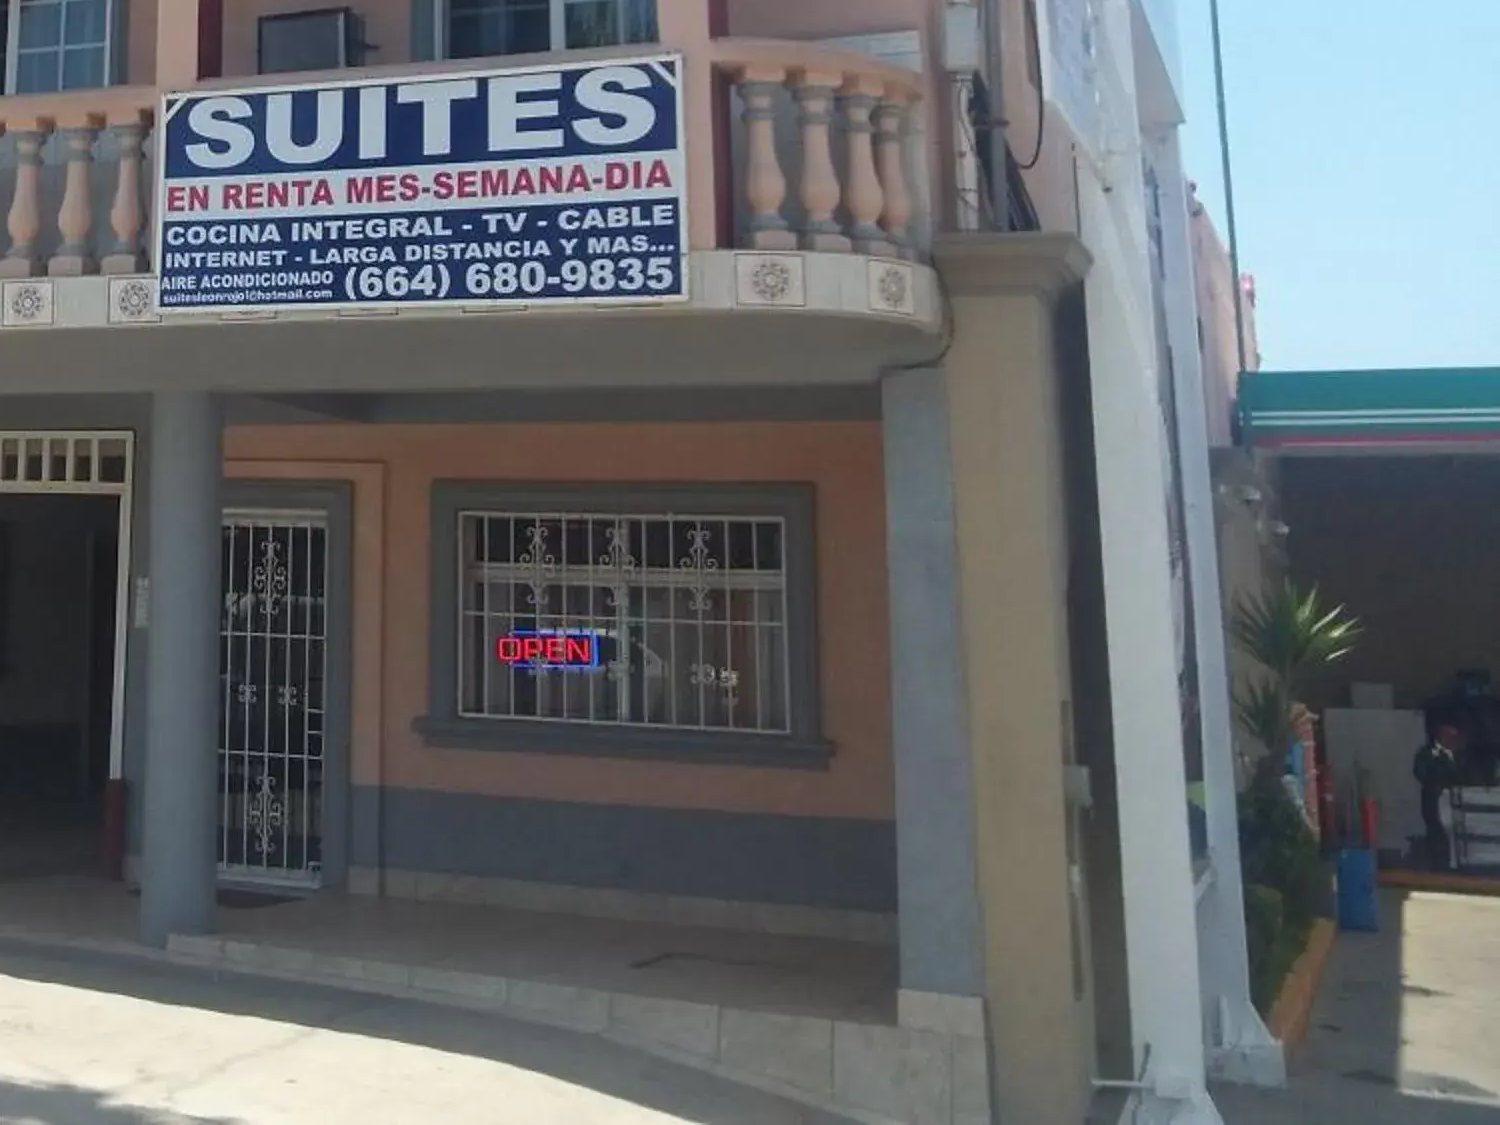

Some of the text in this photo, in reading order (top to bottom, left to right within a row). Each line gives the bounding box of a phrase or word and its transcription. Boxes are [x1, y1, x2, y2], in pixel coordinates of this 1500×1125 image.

[185, 65, 657, 170] SUITES
[166, 158, 673, 213] EN RENTA MES-SEMANA-DIA
[166, 223, 281, 246] COCINA
[291, 216, 453, 243] INTEGRAL
[482, 212, 528, 234] TV
[557, 204, 675, 231] CABLE
[165, 250, 288, 269] INTERNET
[309, 246, 397, 265] LARGA
[405, 239, 552, 262] DISTANCIA
[559, 238, 579, 256] Y
[161, 270, 334, 291] AIRE ACONDICIONADO
[344, 256, 674, 301] (664) 680-9835
[497, 636, 592, 664] OPEN
